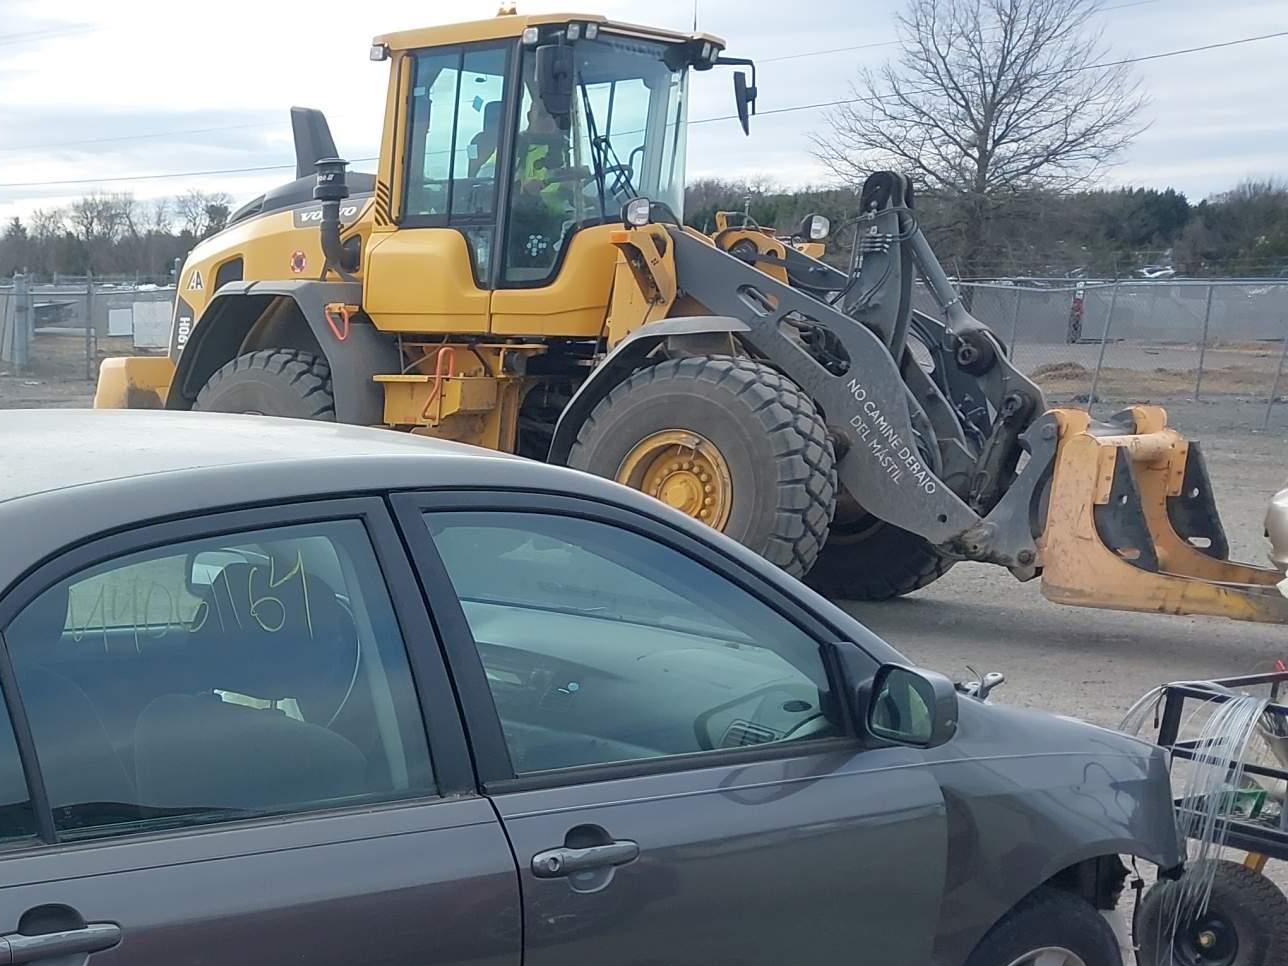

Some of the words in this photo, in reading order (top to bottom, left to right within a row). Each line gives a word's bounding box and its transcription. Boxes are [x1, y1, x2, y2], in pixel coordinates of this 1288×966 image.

[847, 378, 866, 401] NO
[863, 401, 904, 449] CAMINE
[898, 447, 936, 495] DEBAJO
[850, 415, 869, 441] DEL
